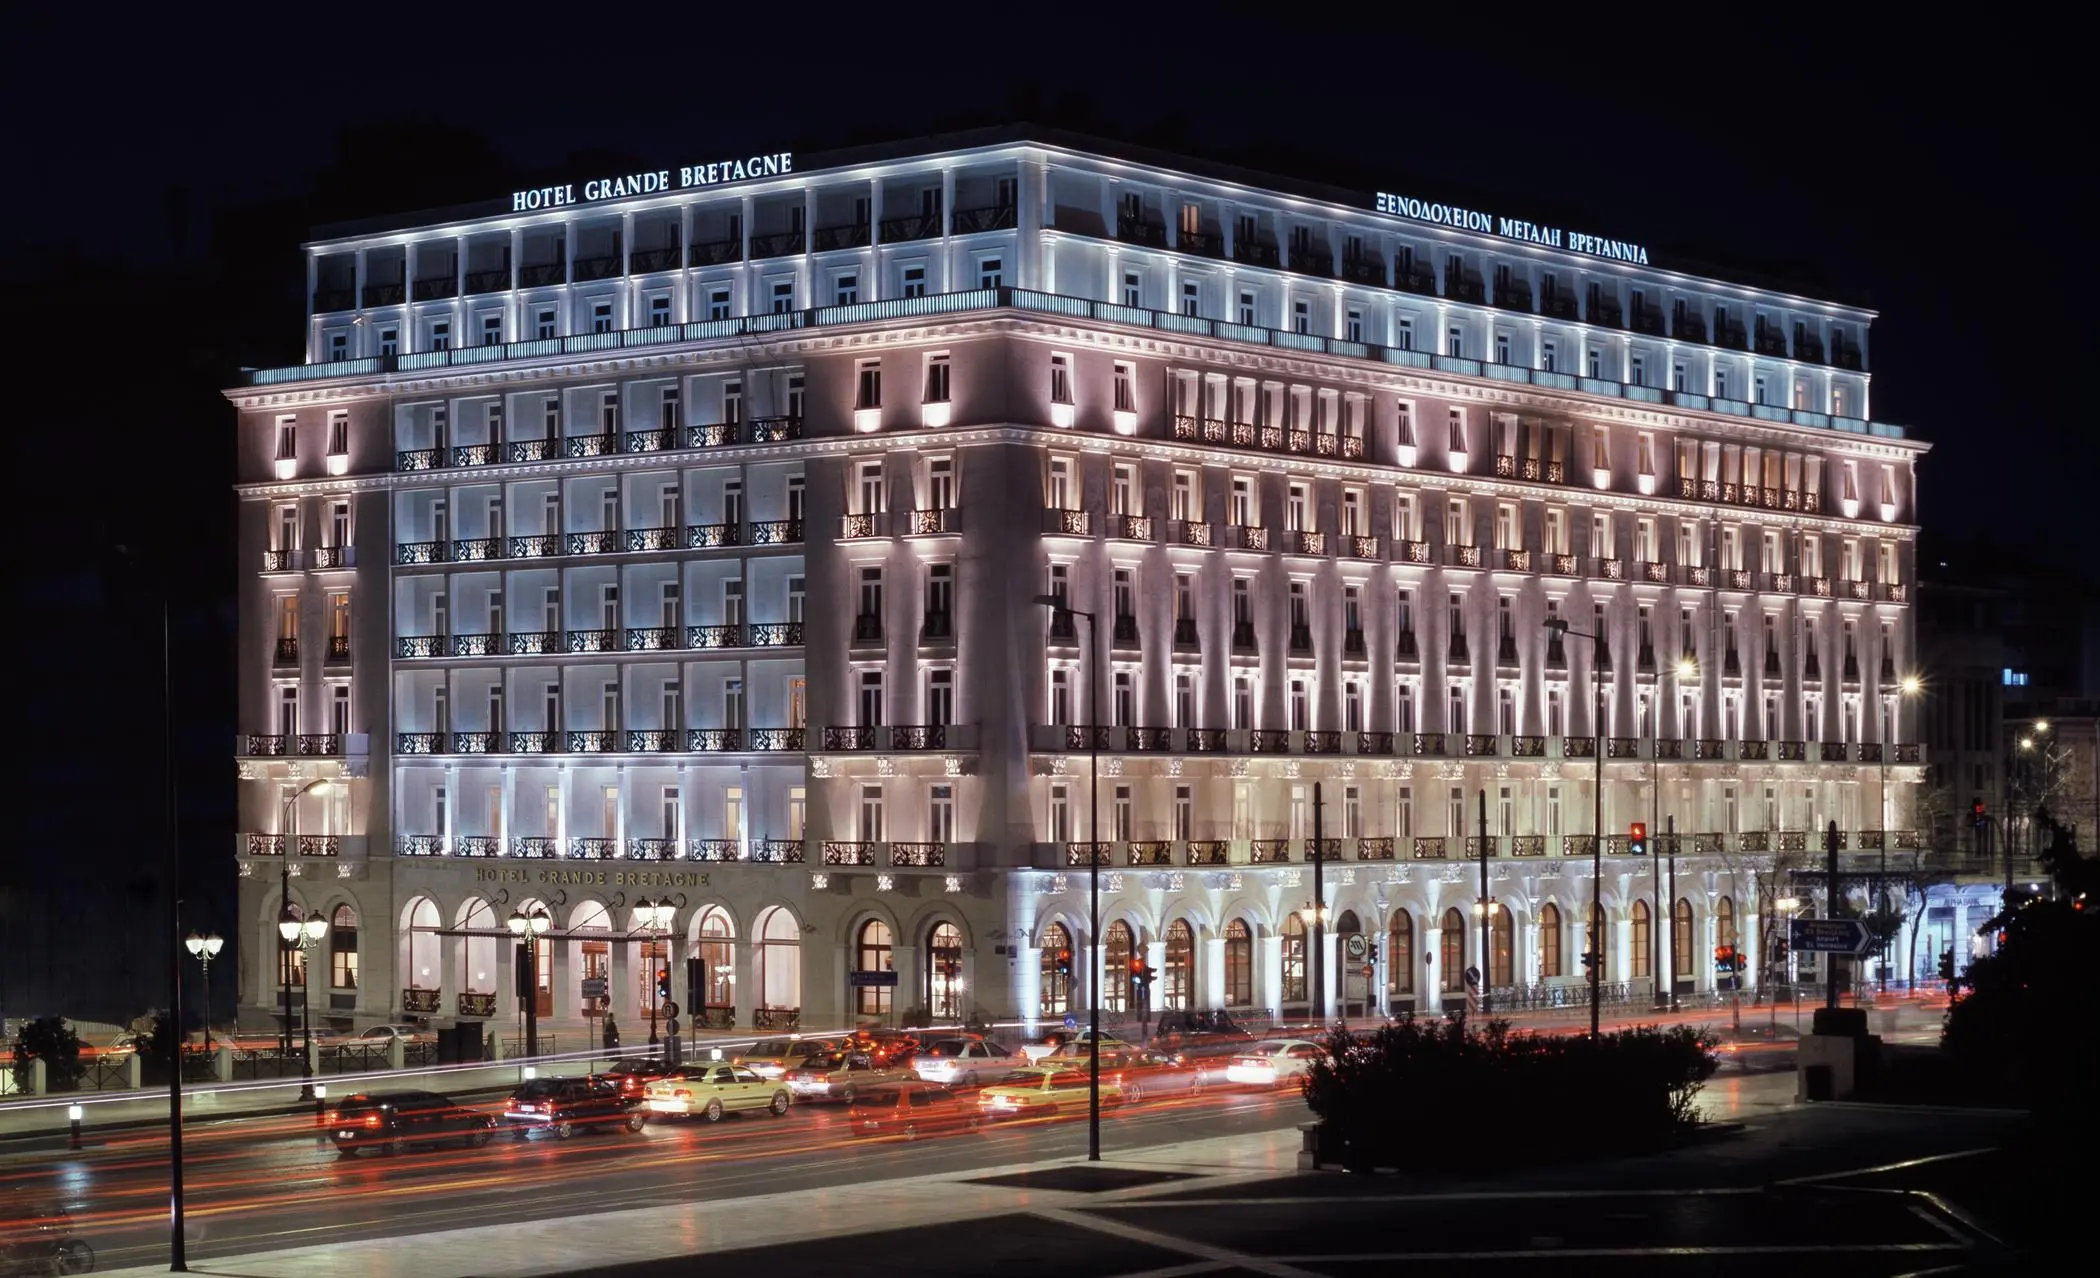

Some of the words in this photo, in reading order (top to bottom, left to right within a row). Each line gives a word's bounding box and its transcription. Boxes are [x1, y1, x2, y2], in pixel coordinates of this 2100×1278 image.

[513, 184, 577, 212] HOTEL
[584, 170, 669, 201] GRANDE
[680, 152, 792, 188] BRETAGNE
[1376, 191, 1493, 233] ΞΕΝΟΔΟΧΕΙΟΝ
[1500, 217, 1561, 247] ΜΕΓΑΛΗ
[1568, 231, 1649, 265] ΒΡΕΤΑΝΝΙΑ
[476, 867, 530, 882] HOTEL
[539, 871, 606, 885] GRANDE
[616, 872, 709, 886] BRETAGNE
